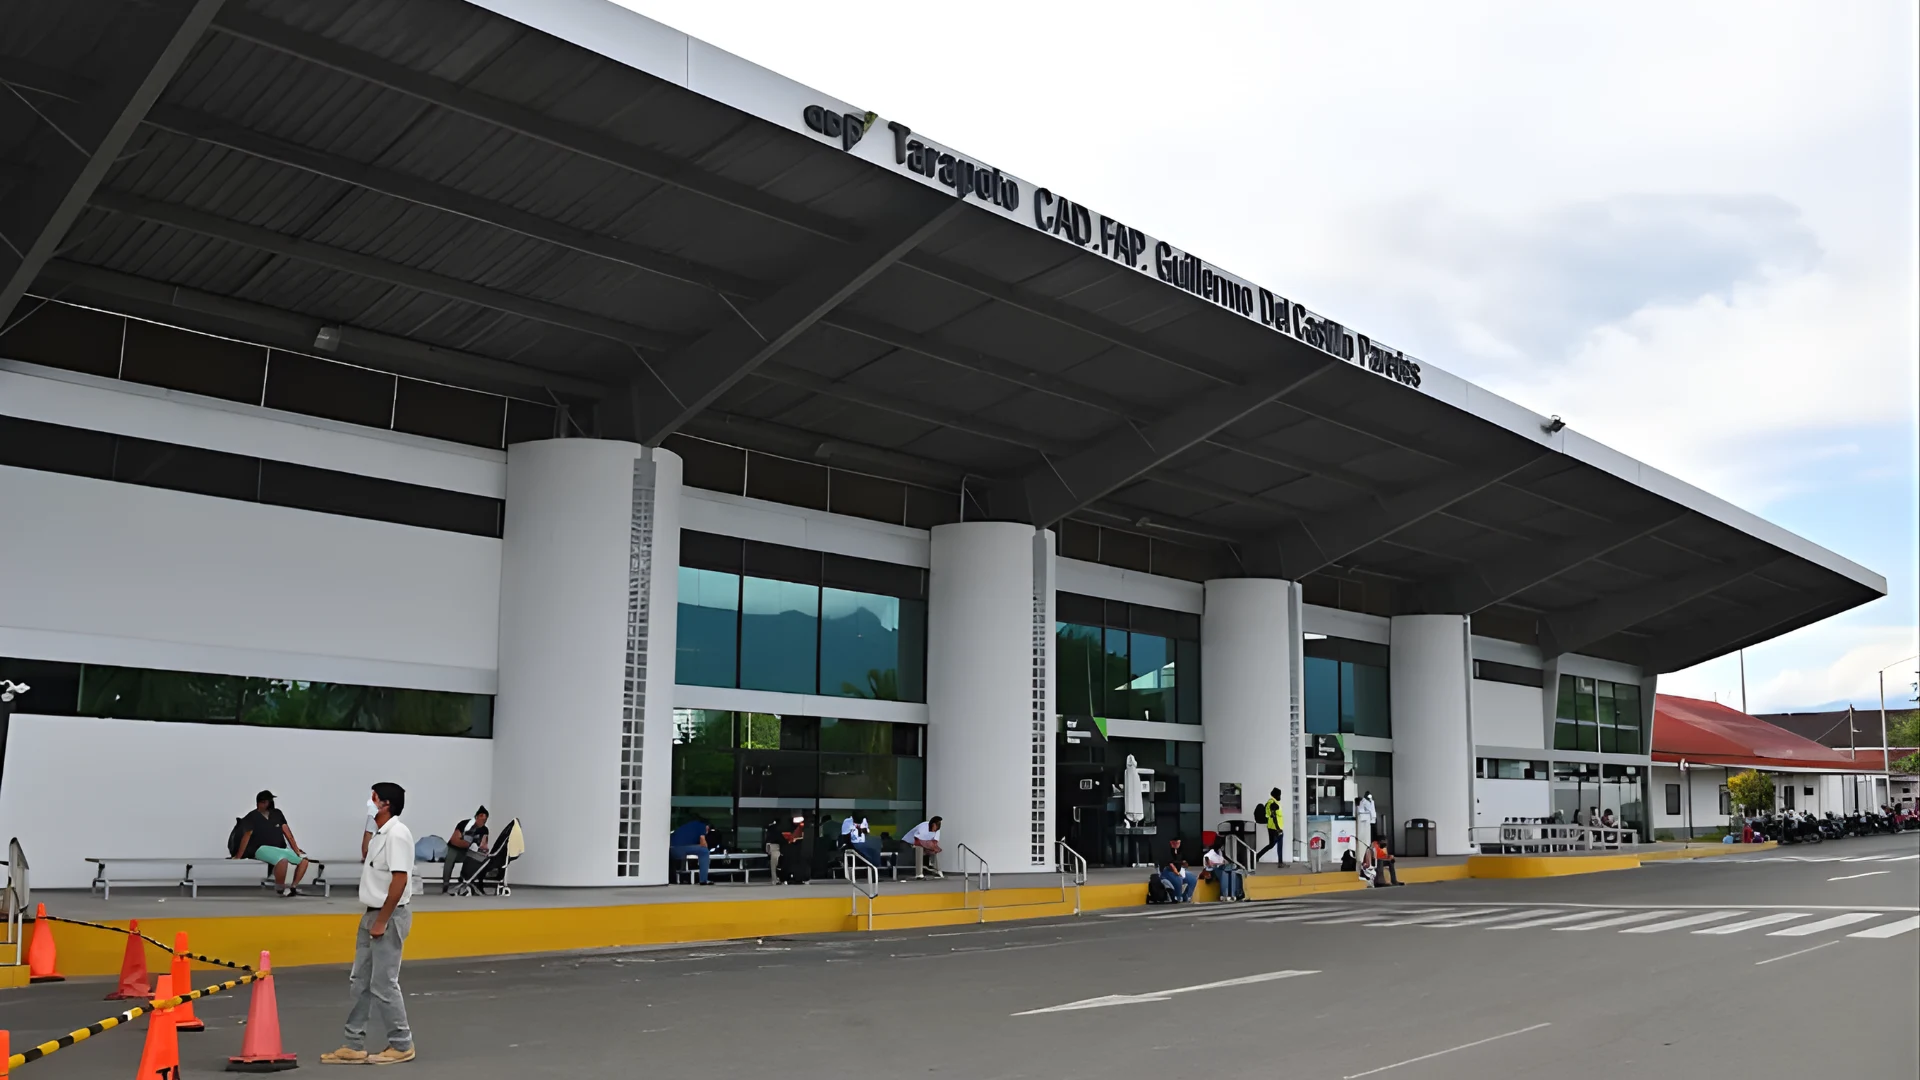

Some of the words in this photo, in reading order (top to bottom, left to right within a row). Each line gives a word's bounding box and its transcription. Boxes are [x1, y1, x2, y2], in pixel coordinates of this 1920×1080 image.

[888, 120, 1020, 212] Tarapoto
[1155, 241, 1254, 317] Guillermo
[1258, 286, 1291, 334] Del
[1292, 303, 1354, 361] Castillo
